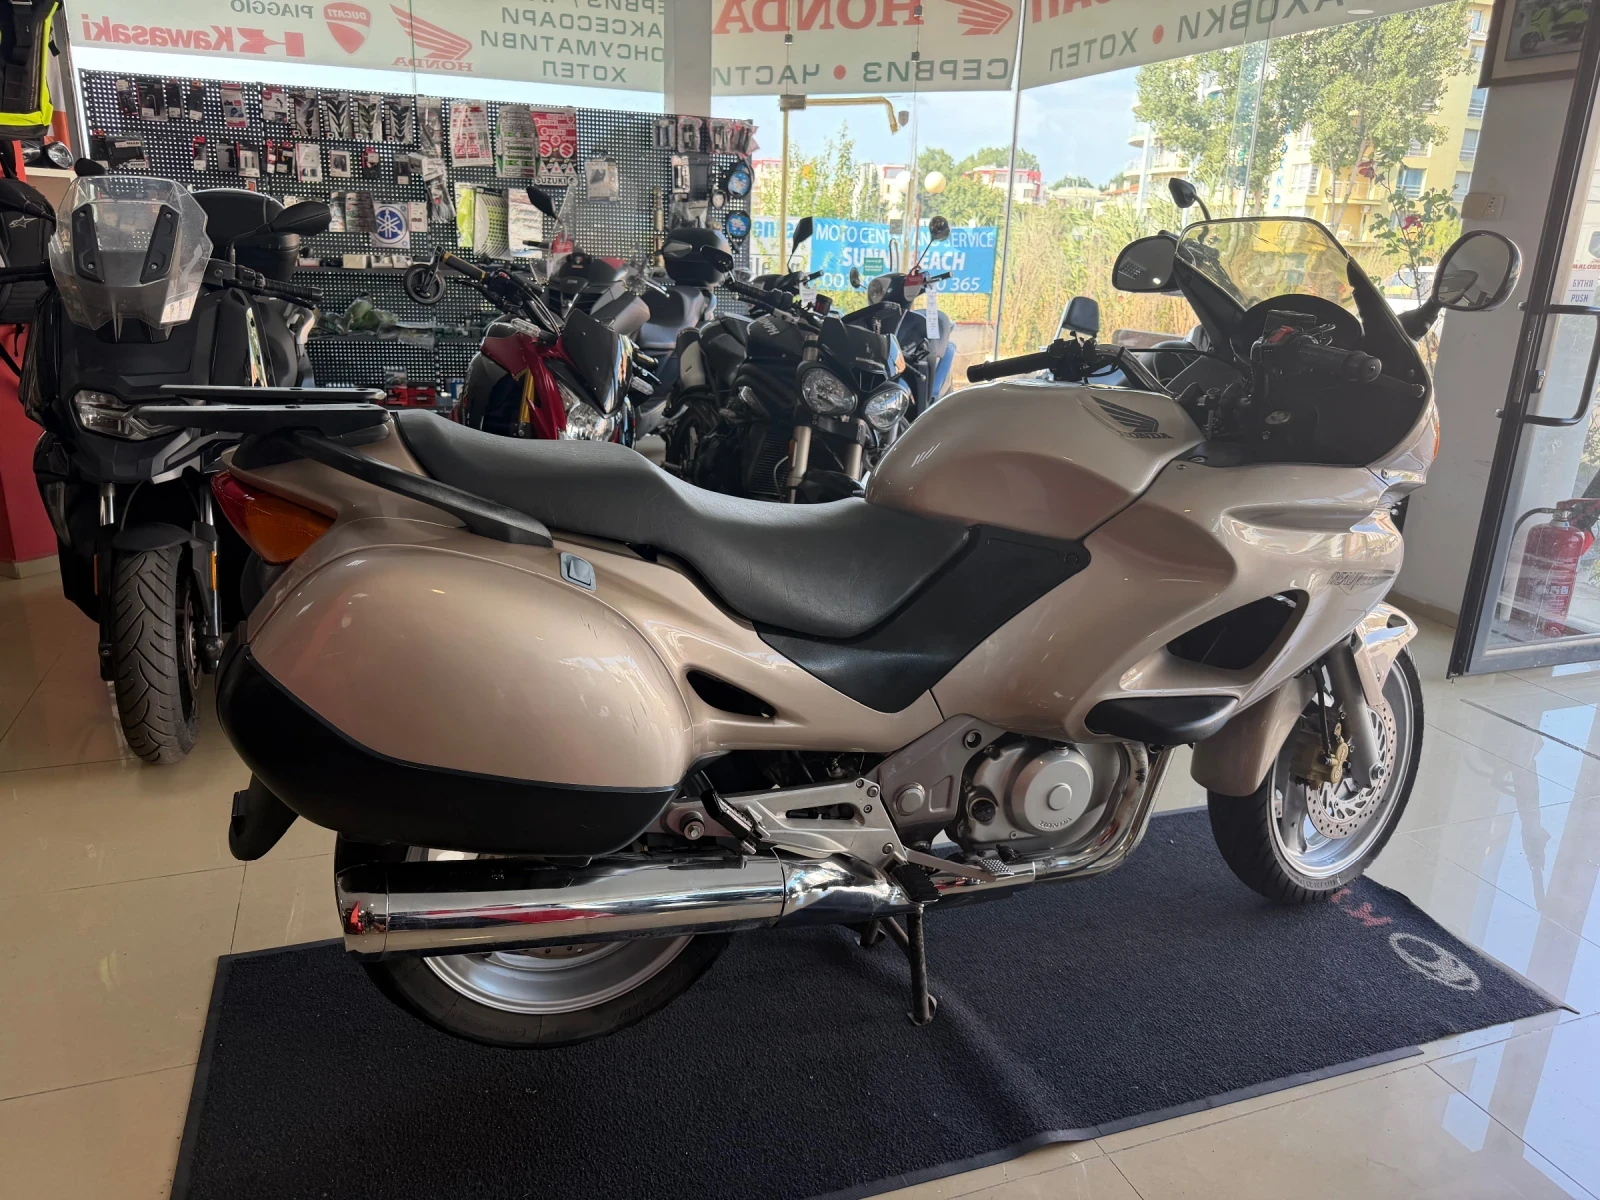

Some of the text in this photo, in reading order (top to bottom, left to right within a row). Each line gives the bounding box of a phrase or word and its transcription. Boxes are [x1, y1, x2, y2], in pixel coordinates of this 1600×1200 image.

[536, 177, 566, 185] SUZUKI
[816, 223, 858, 243] MOTO
[912, 231, 942, 248] AN
[944, 231, 993, 248] ERVICE
[950, 277, 980, 292] 365
[1570, 294, 1589, 303] PUSH
